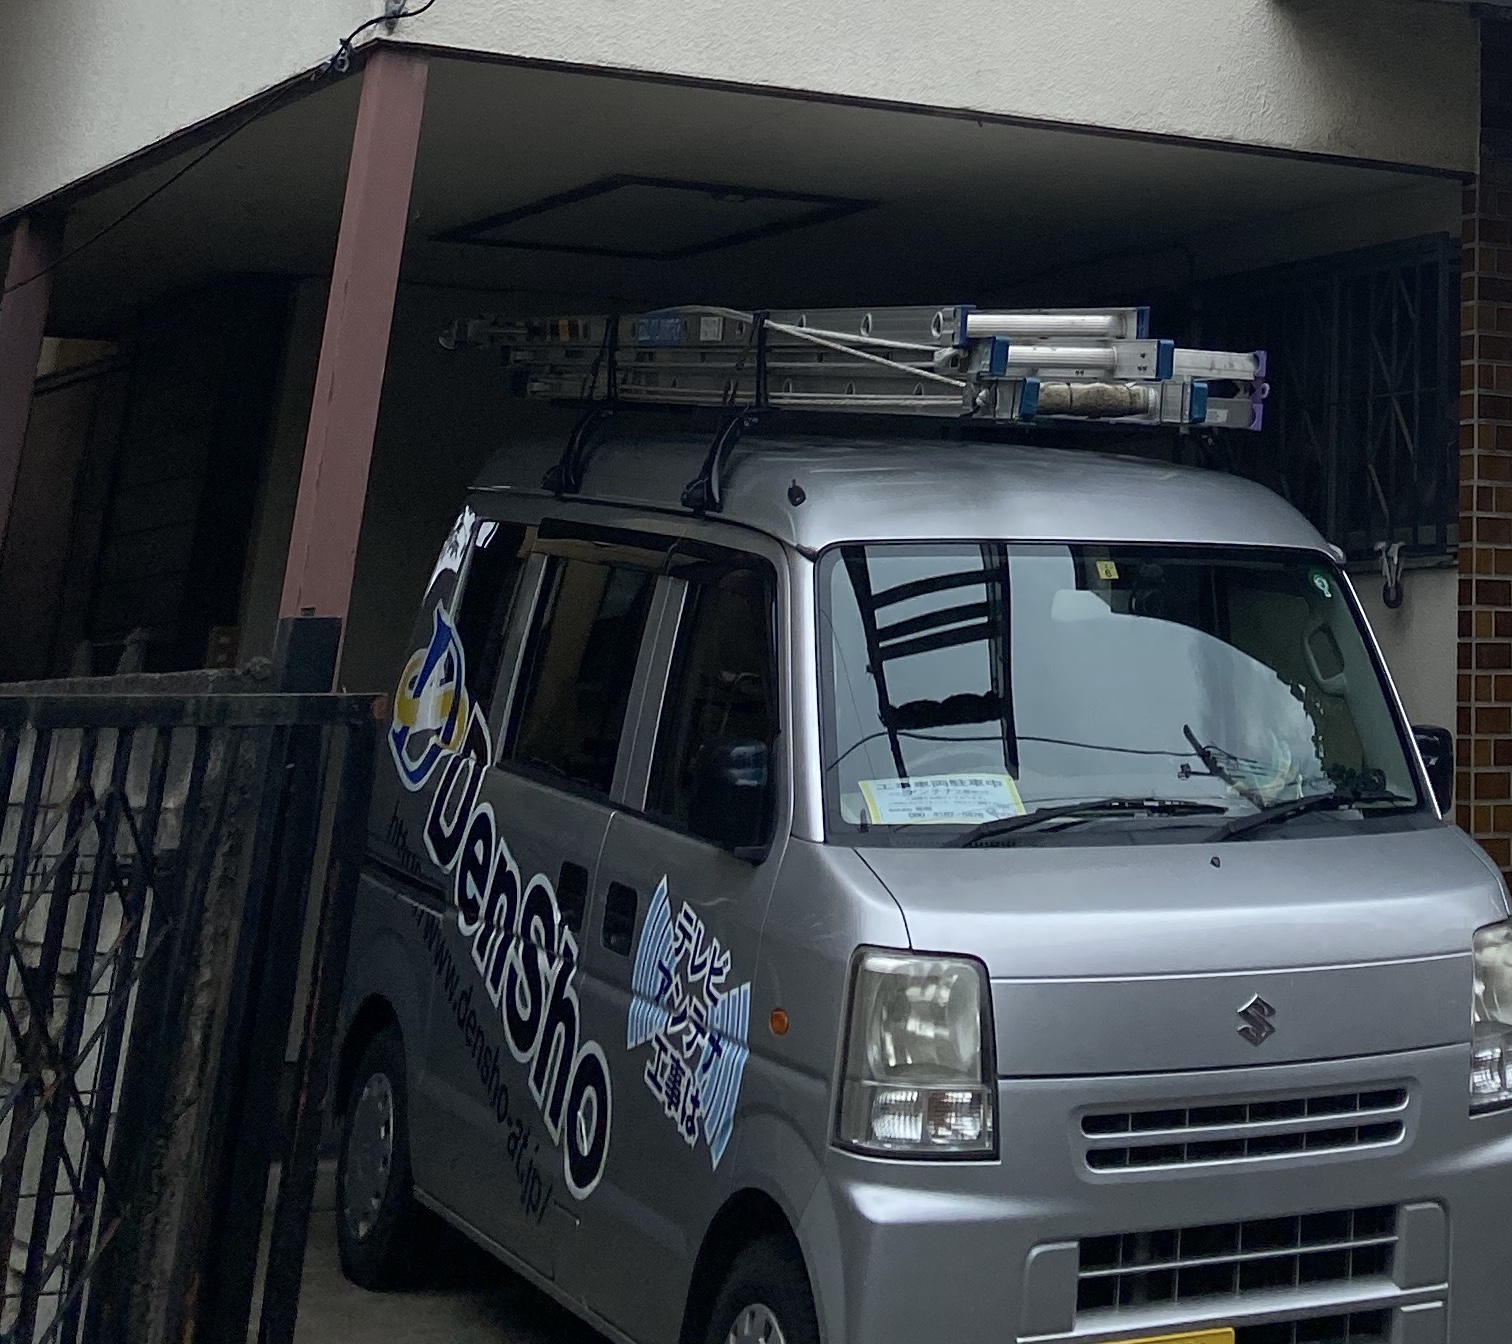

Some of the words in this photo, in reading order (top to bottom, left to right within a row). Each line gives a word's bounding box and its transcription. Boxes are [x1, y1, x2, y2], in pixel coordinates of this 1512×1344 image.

[676, 901, 731, 1008] テレビ
[657, 959, 722, 1075] アンテナ
[644, 1031, 699, 1149] 工事は
